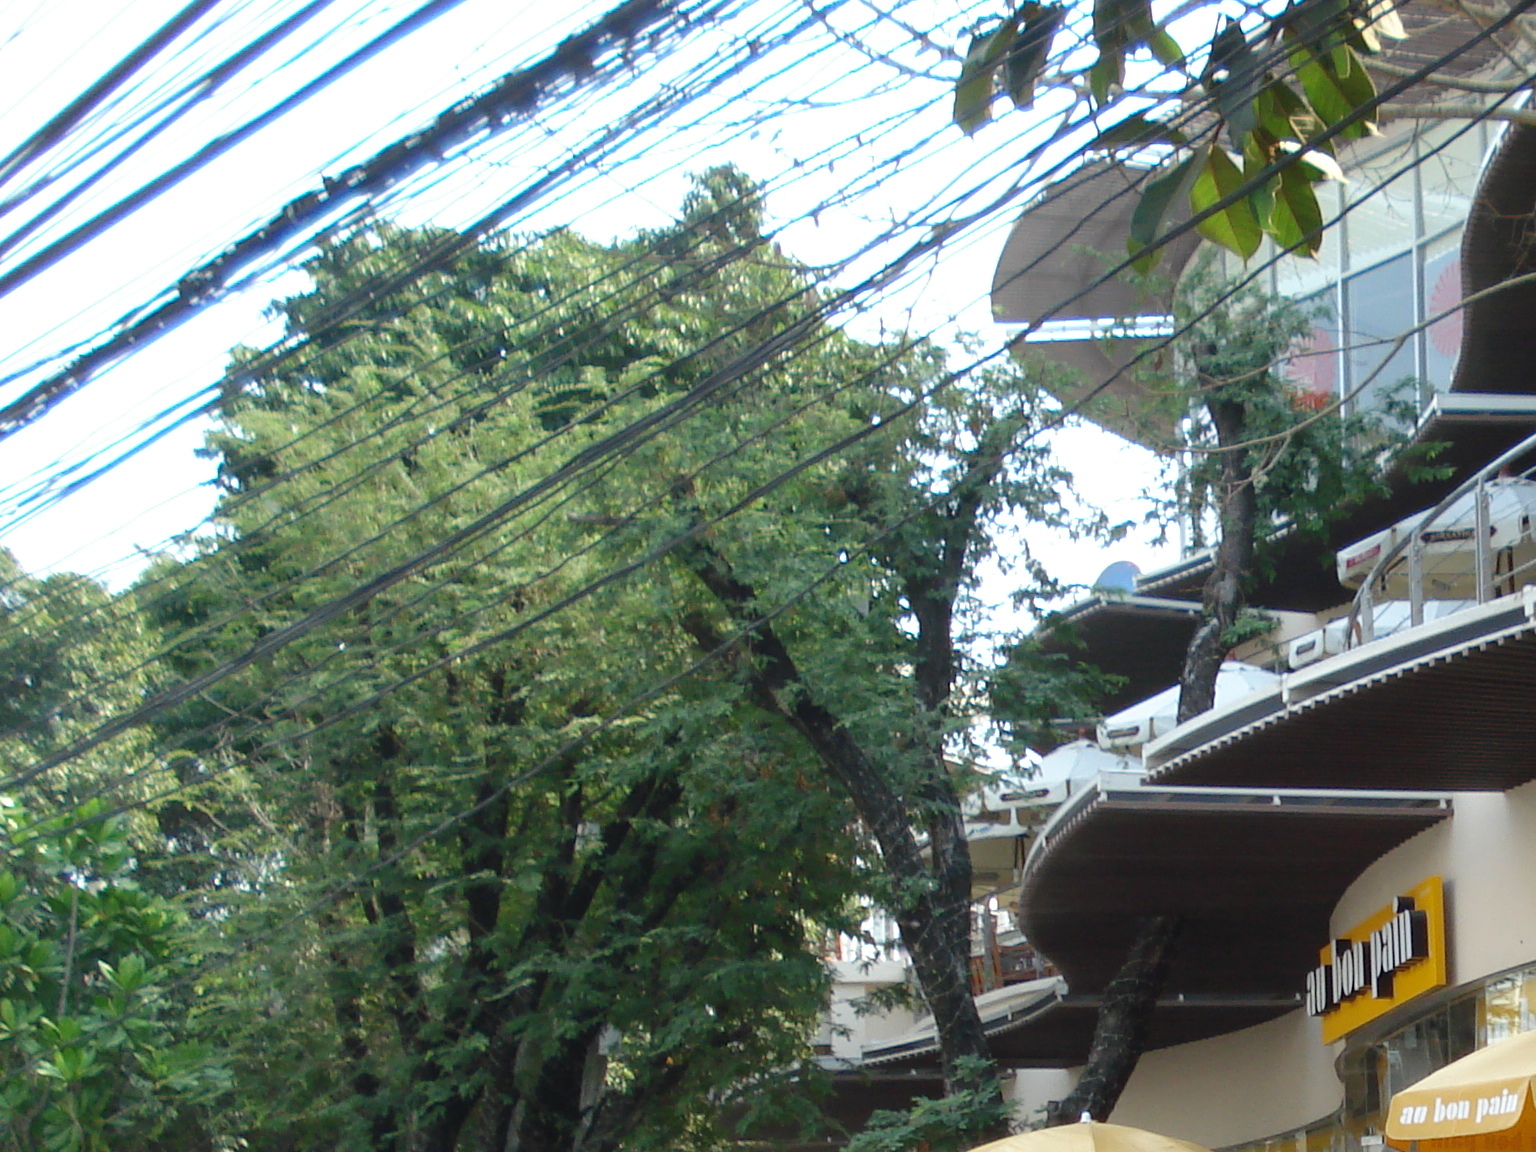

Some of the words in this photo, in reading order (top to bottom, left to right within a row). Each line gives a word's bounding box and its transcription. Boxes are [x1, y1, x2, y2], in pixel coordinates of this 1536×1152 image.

[1306, 965, 1326, 1017] au
[1331, 939, 1364, 1004] bon
[1370, 896, 1412, 999] pain
[1400, 1105, 1427, 1125] au
[1434, 1097, 1470, 1123] bon
[1475, 1088, 1519, 1124] pain
